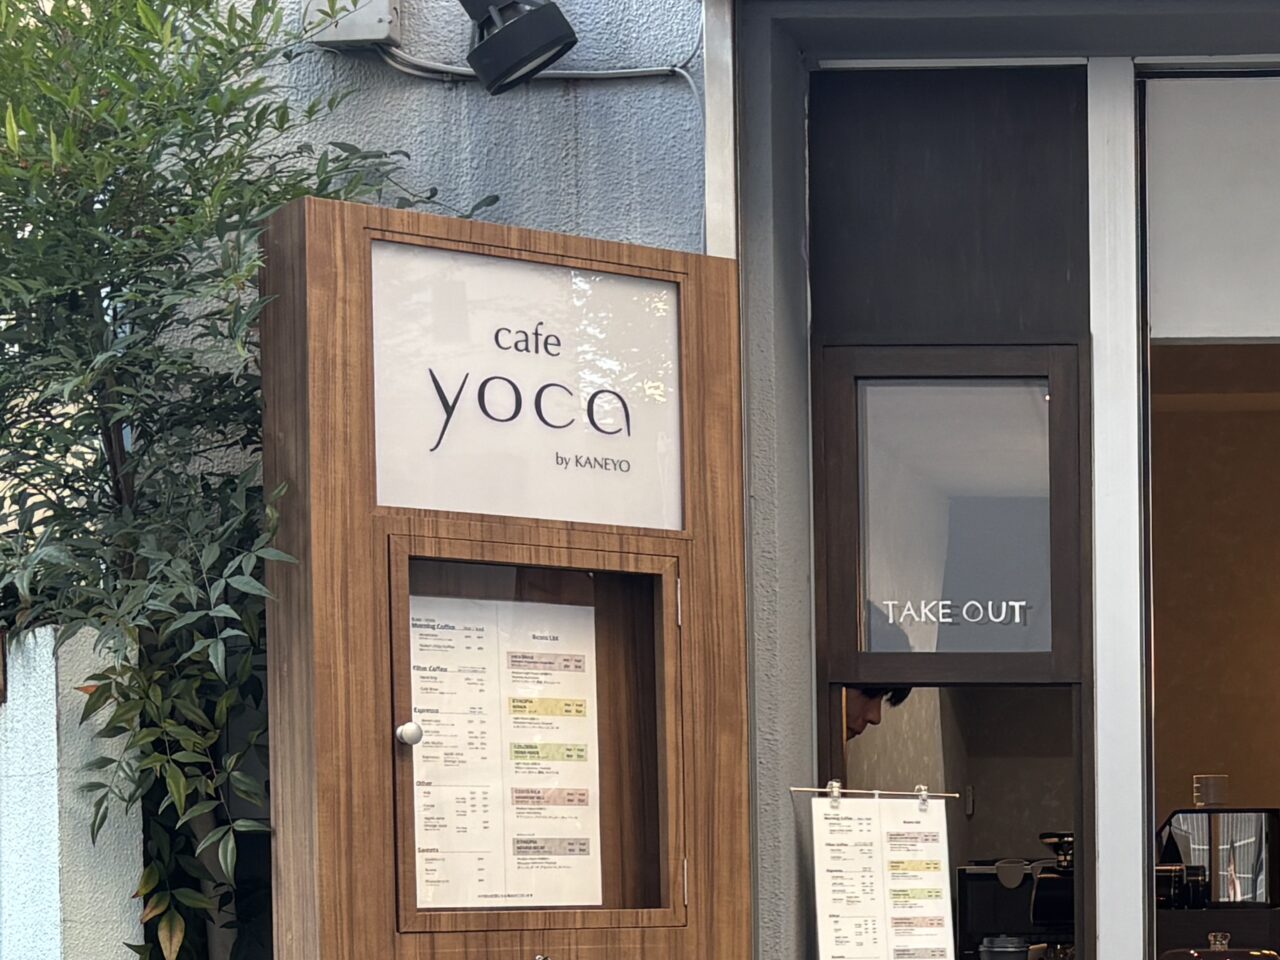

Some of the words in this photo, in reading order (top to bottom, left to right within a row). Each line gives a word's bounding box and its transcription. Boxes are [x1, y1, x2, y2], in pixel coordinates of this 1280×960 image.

[494, 321, 562, 357] cafe
[428, 367, 632, 452] yoca
[555, 452, 571, 470] by
[574, 455, 631, 473] KANEYO
[882, 600, 953, 624] TAKE
[962, 600, 1027, 623] OUT
